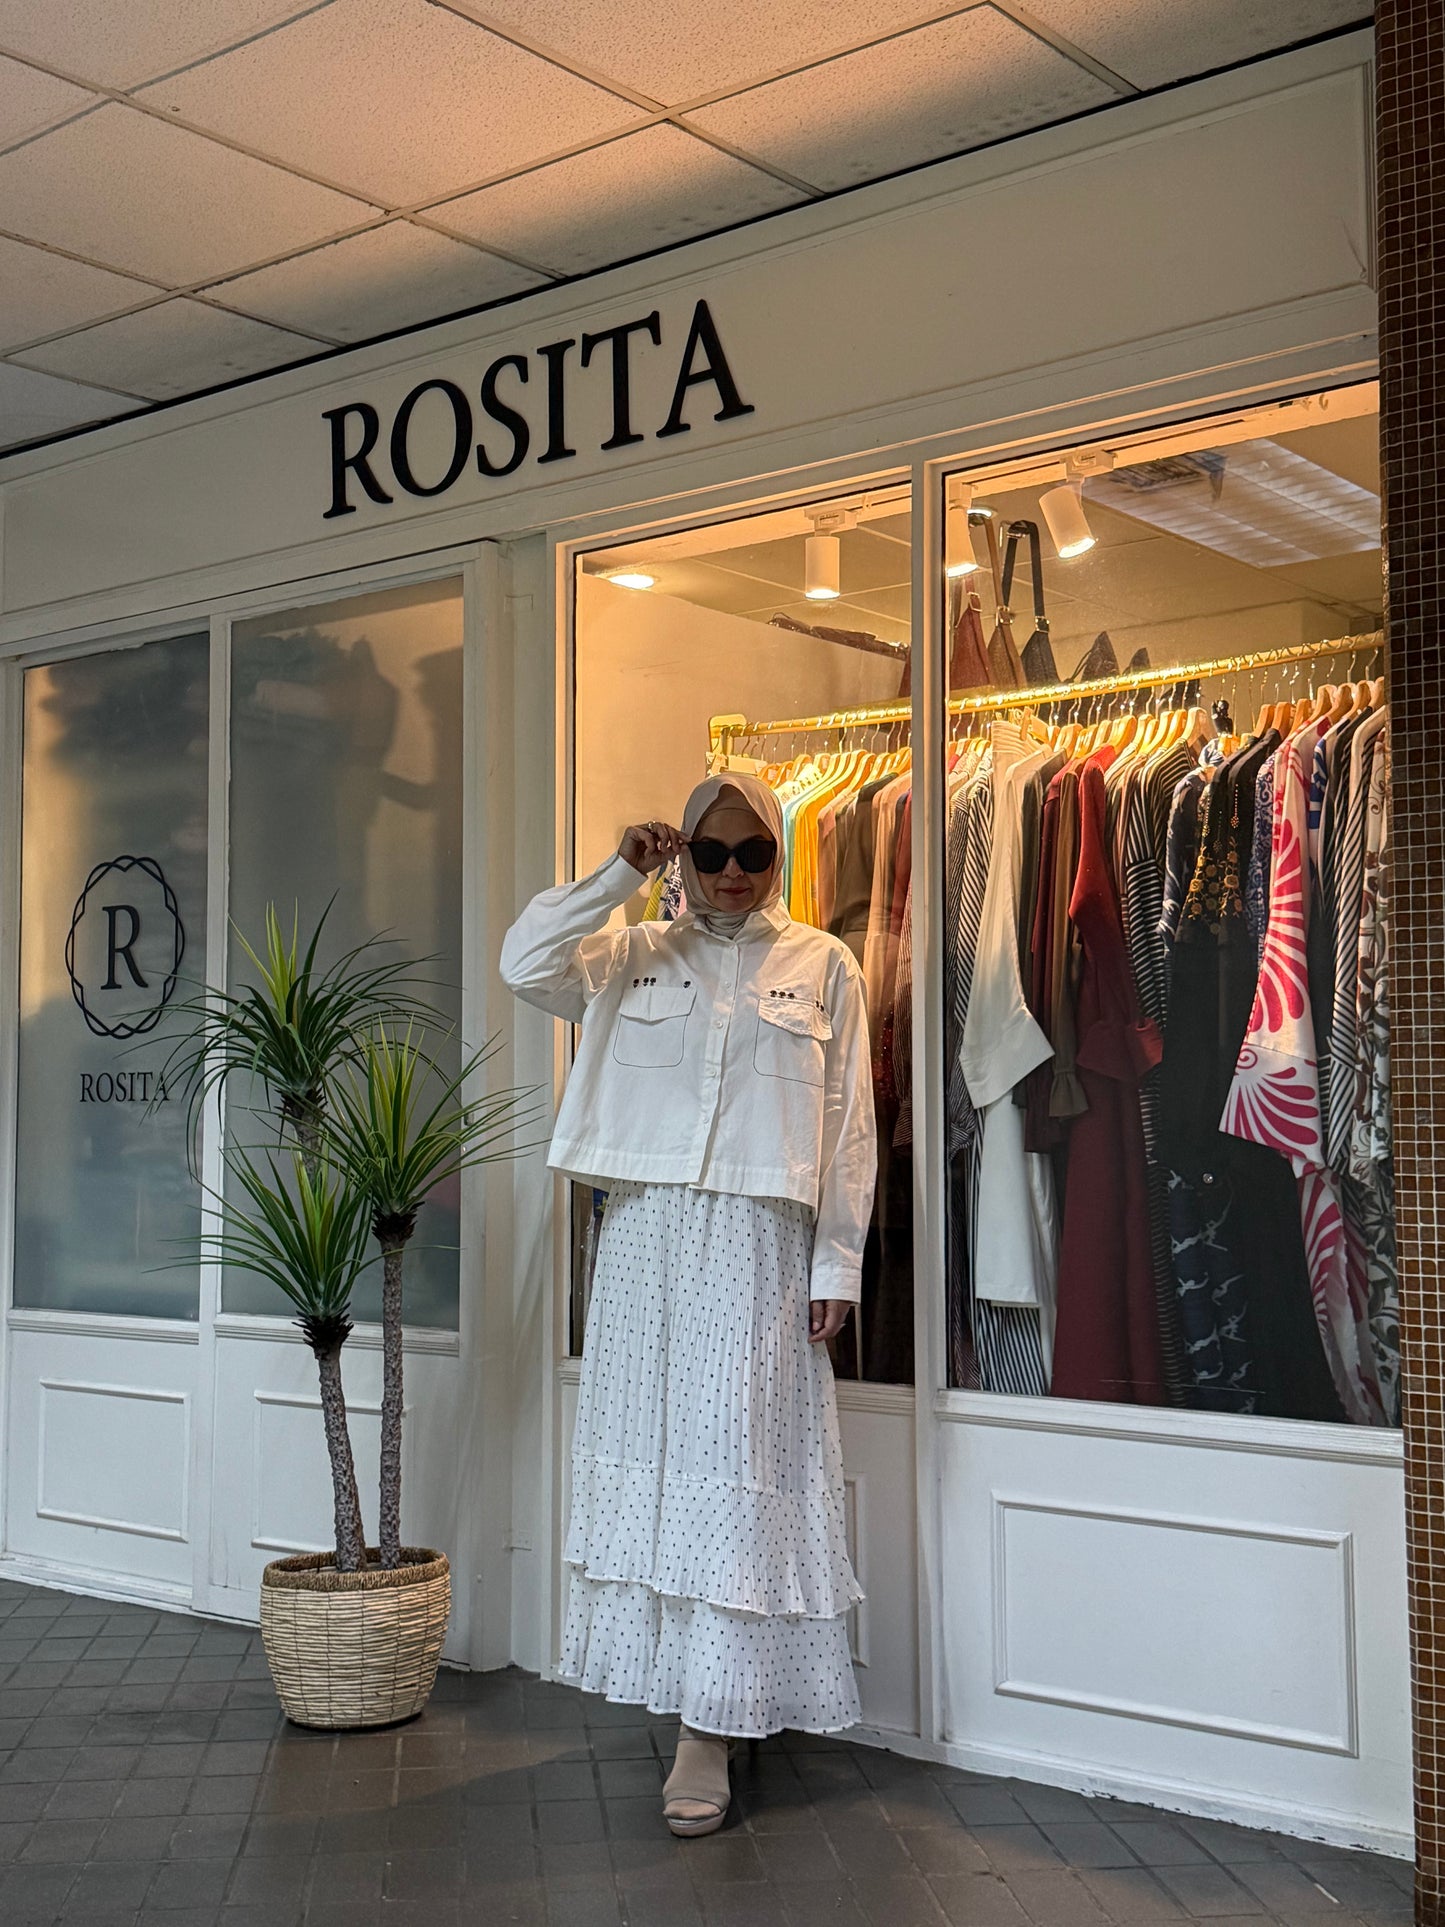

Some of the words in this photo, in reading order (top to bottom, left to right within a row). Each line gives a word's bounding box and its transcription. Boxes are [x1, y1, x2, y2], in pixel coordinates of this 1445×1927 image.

[322, 299, 755, 519] ROSITA
[101, 905, 149, 990] R
[80, 1072, 170, 1102] ROSITA
